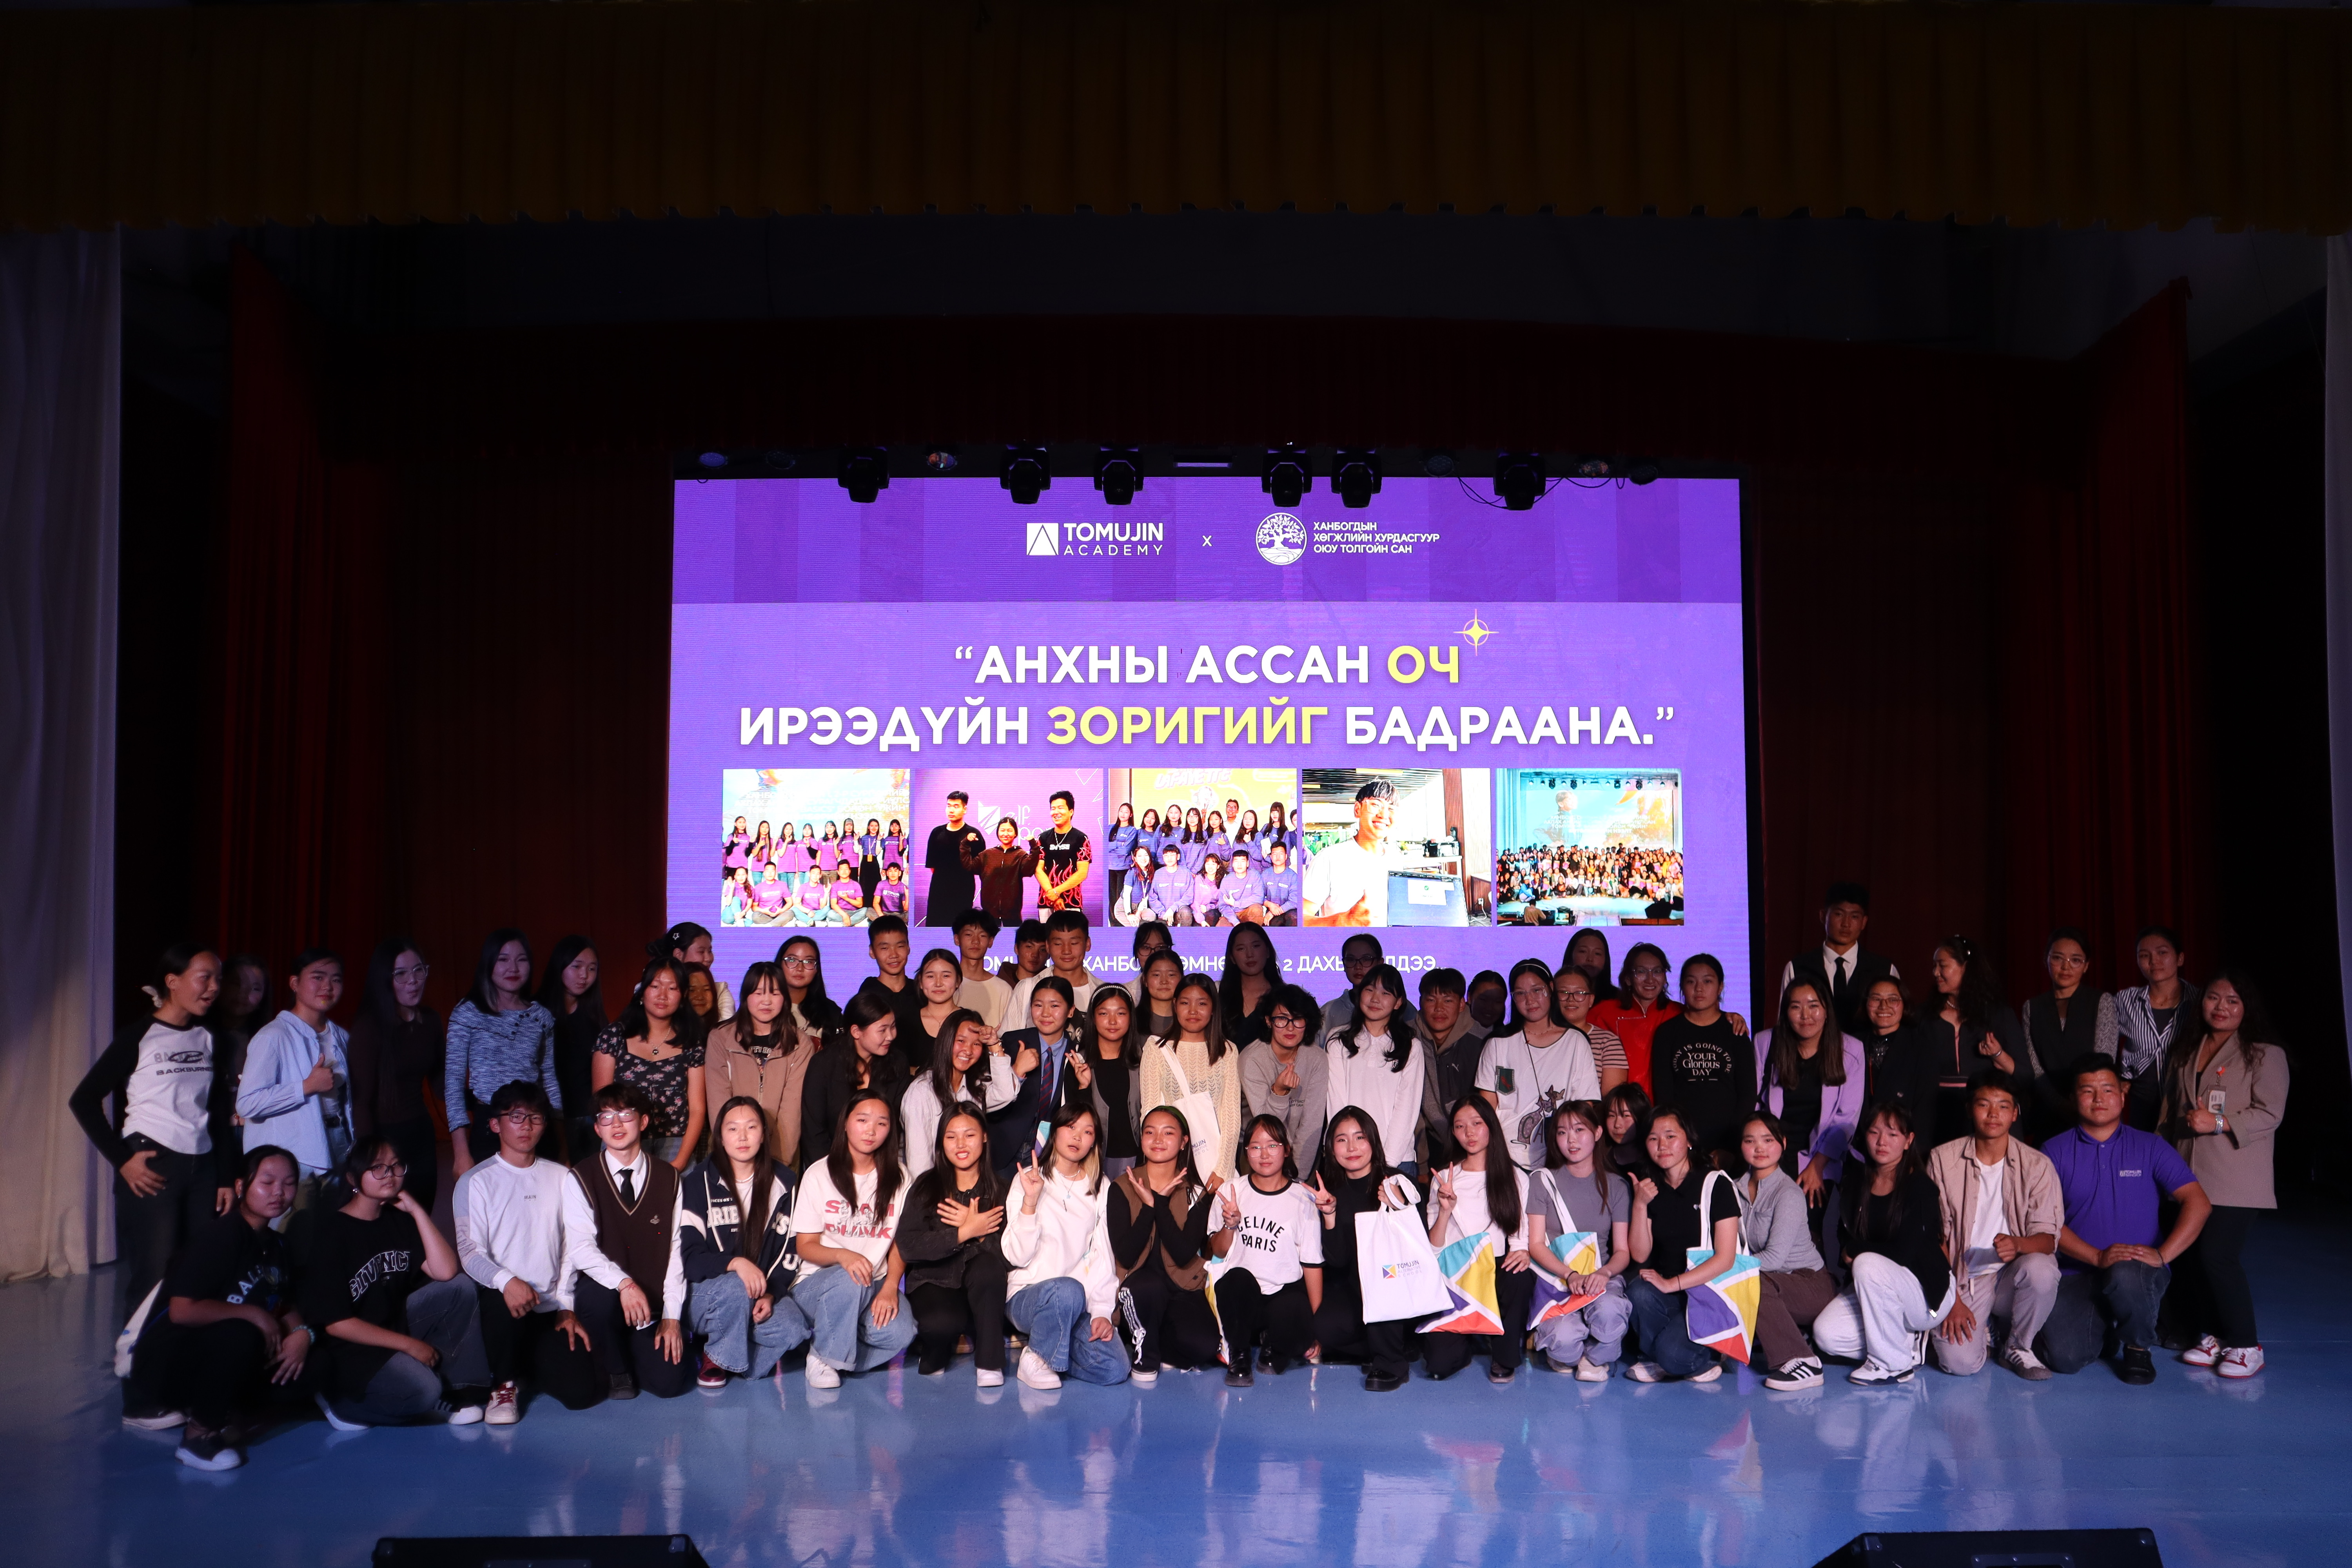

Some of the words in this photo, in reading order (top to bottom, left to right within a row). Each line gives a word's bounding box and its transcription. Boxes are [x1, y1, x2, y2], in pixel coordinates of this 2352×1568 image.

[1063, 523, 1163, 541] TOMUJIN
[1313, 522, 1377, 532] ХАНБОГДЫН
[1313, 531, 1372, 542] ХӨГЖЛИЙН
[1374, 533, 1440, 543] ХУРДАСГУУР
[1063, 544, 1163, 555] ACADEMY
[1314, 544, 1338, 553] ОЮУ
[1340, 543, 1388, 553] ТОЛГОЙН
[1390, 544, 1412, 553] САН
[955, 645, 1167, 683] “АНХНЫ
[1185, 645, 1368, 684] АССАН
[1387, 645, 1459, 684] ОЧ
[740, 696, 1028, 752] ИРЭЭДҮЙН
[1047, 696, 1328, 744] ЗОРИГИЙГ
[1283, 959, 1293, 971] 2
[1695, 1043, 1723, 1053] GOING
[1723, 1051, 1731, 1062] TO
[1682, 1059, 1720, 1069] Glorious
[1192, 1139, 1206, 1150] MUJIN
[1241, 1234, 1277, 1252] PARIS
[1397, 1260, 1419, 1269] TOMUJIN
